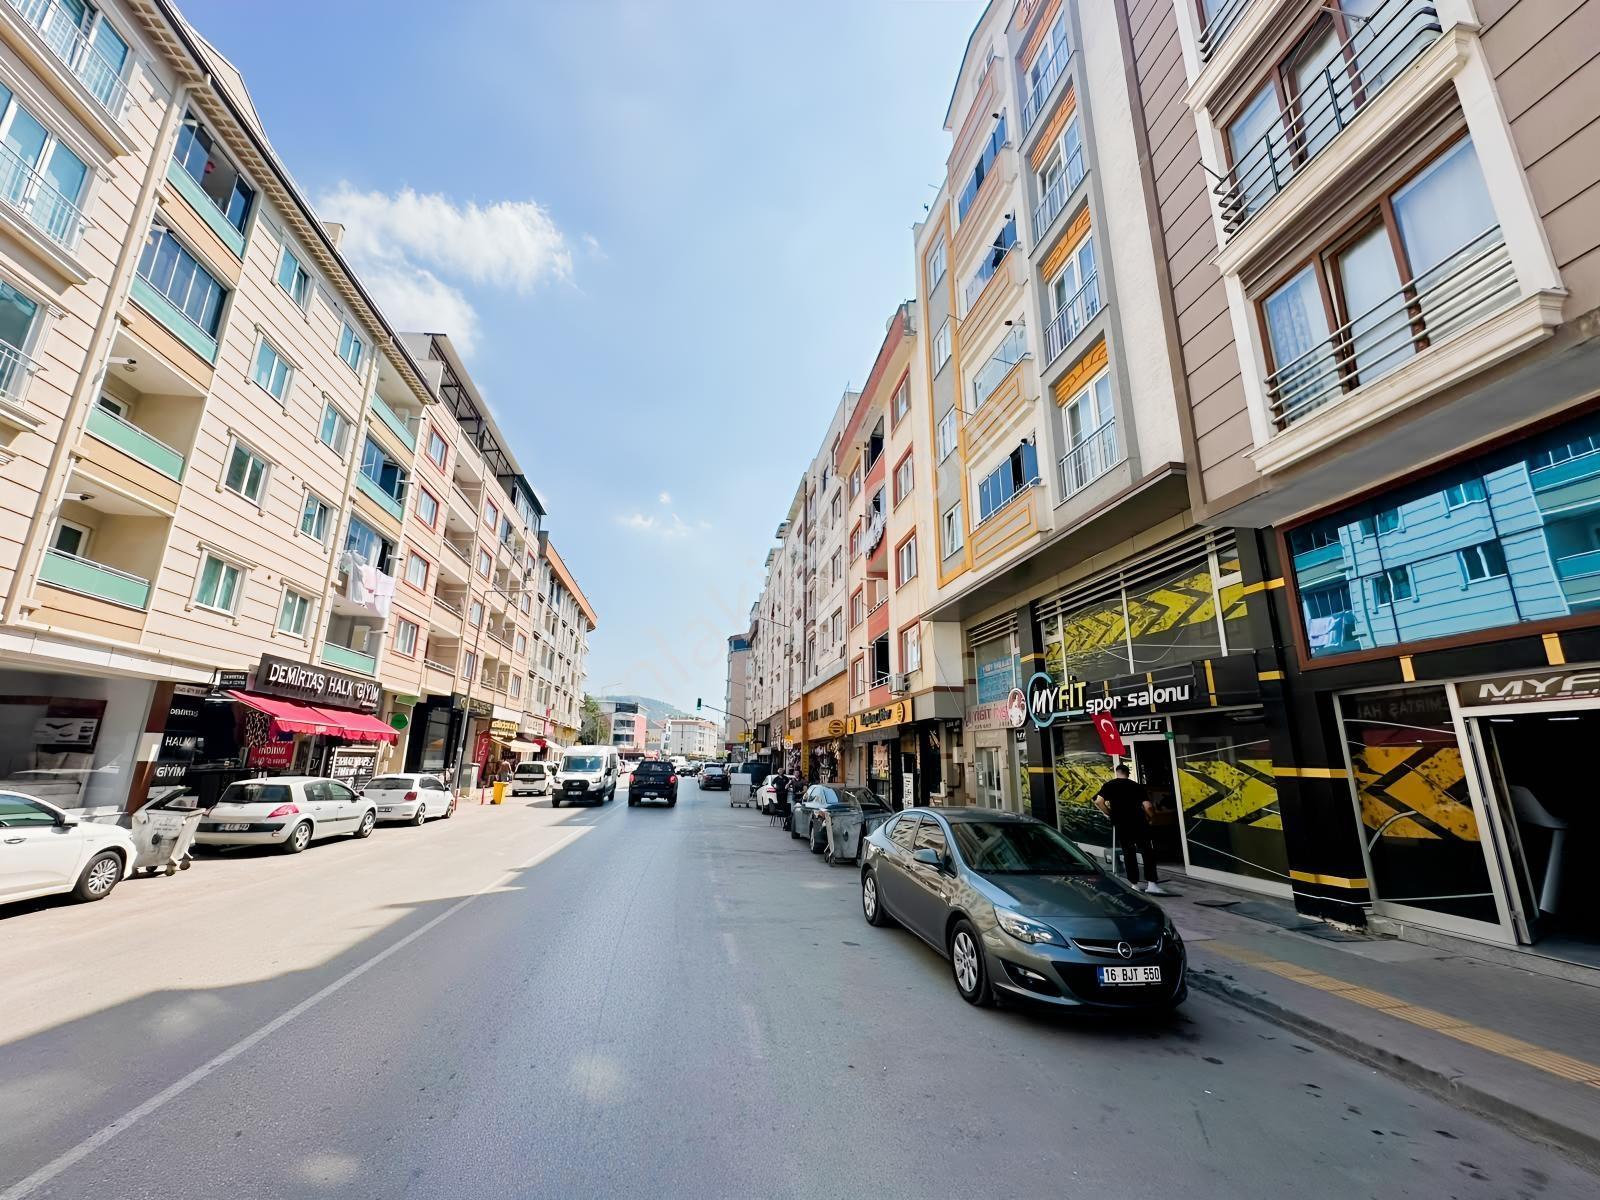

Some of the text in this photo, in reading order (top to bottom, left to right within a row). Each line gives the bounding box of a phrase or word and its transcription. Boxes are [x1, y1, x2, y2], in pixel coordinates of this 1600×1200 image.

[269, 663, 379, 702] DEMİRTAŞ HALK GİYİM
[1086, 696, 1121, 715] spor
[1128, 683, 1189, 707] salonu
[156, 764, 186, 777] GİYİM
[1106, 968, 1160, 981] 16 BJT 550
